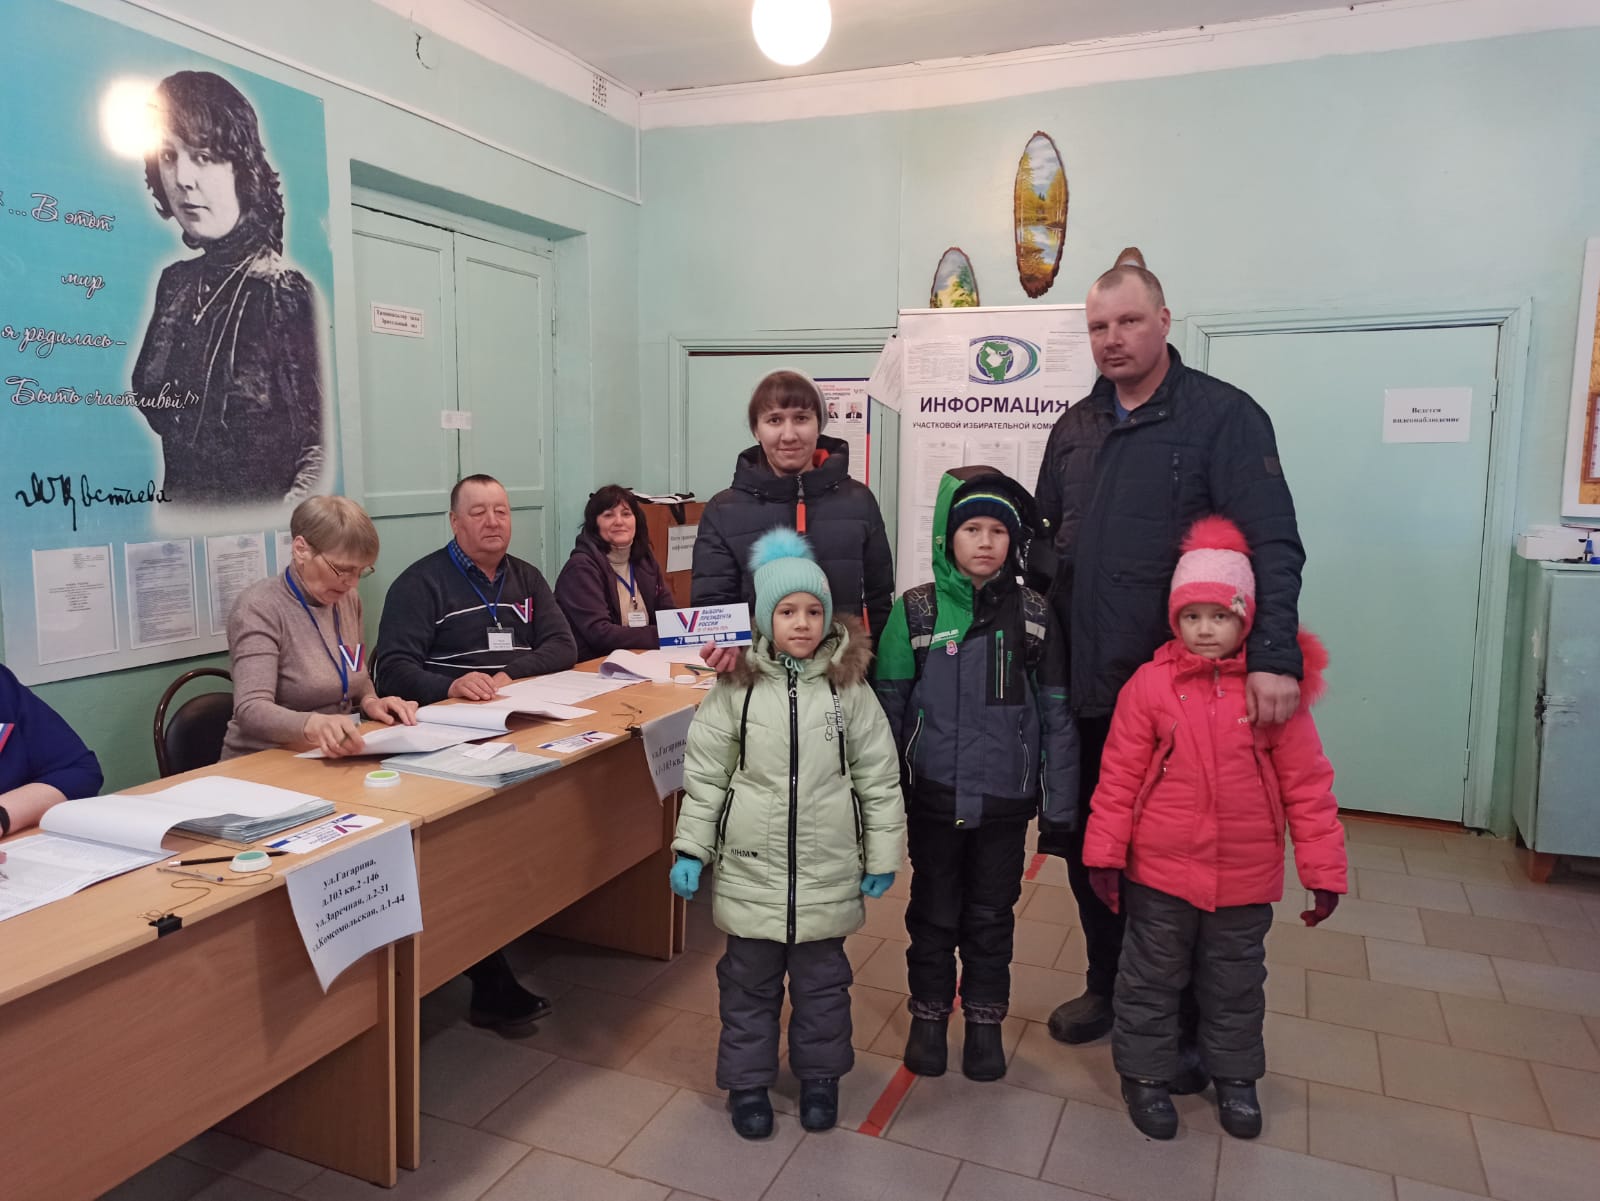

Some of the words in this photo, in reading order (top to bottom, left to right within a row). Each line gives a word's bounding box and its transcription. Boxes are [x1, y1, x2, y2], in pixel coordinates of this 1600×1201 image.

[64, 209, 116, 232] этот
[60, 272, 106, 300] мир
[5, 376, 81, 406] Быть
[920, 396, 1070, 416] ИНФОРМАЦИЯ
[912, 421, 962, 430] УЧАСТКОВОЙ
[963, 421, 1031, 430] ИЗБИРАТЕЛЬНОЙ
